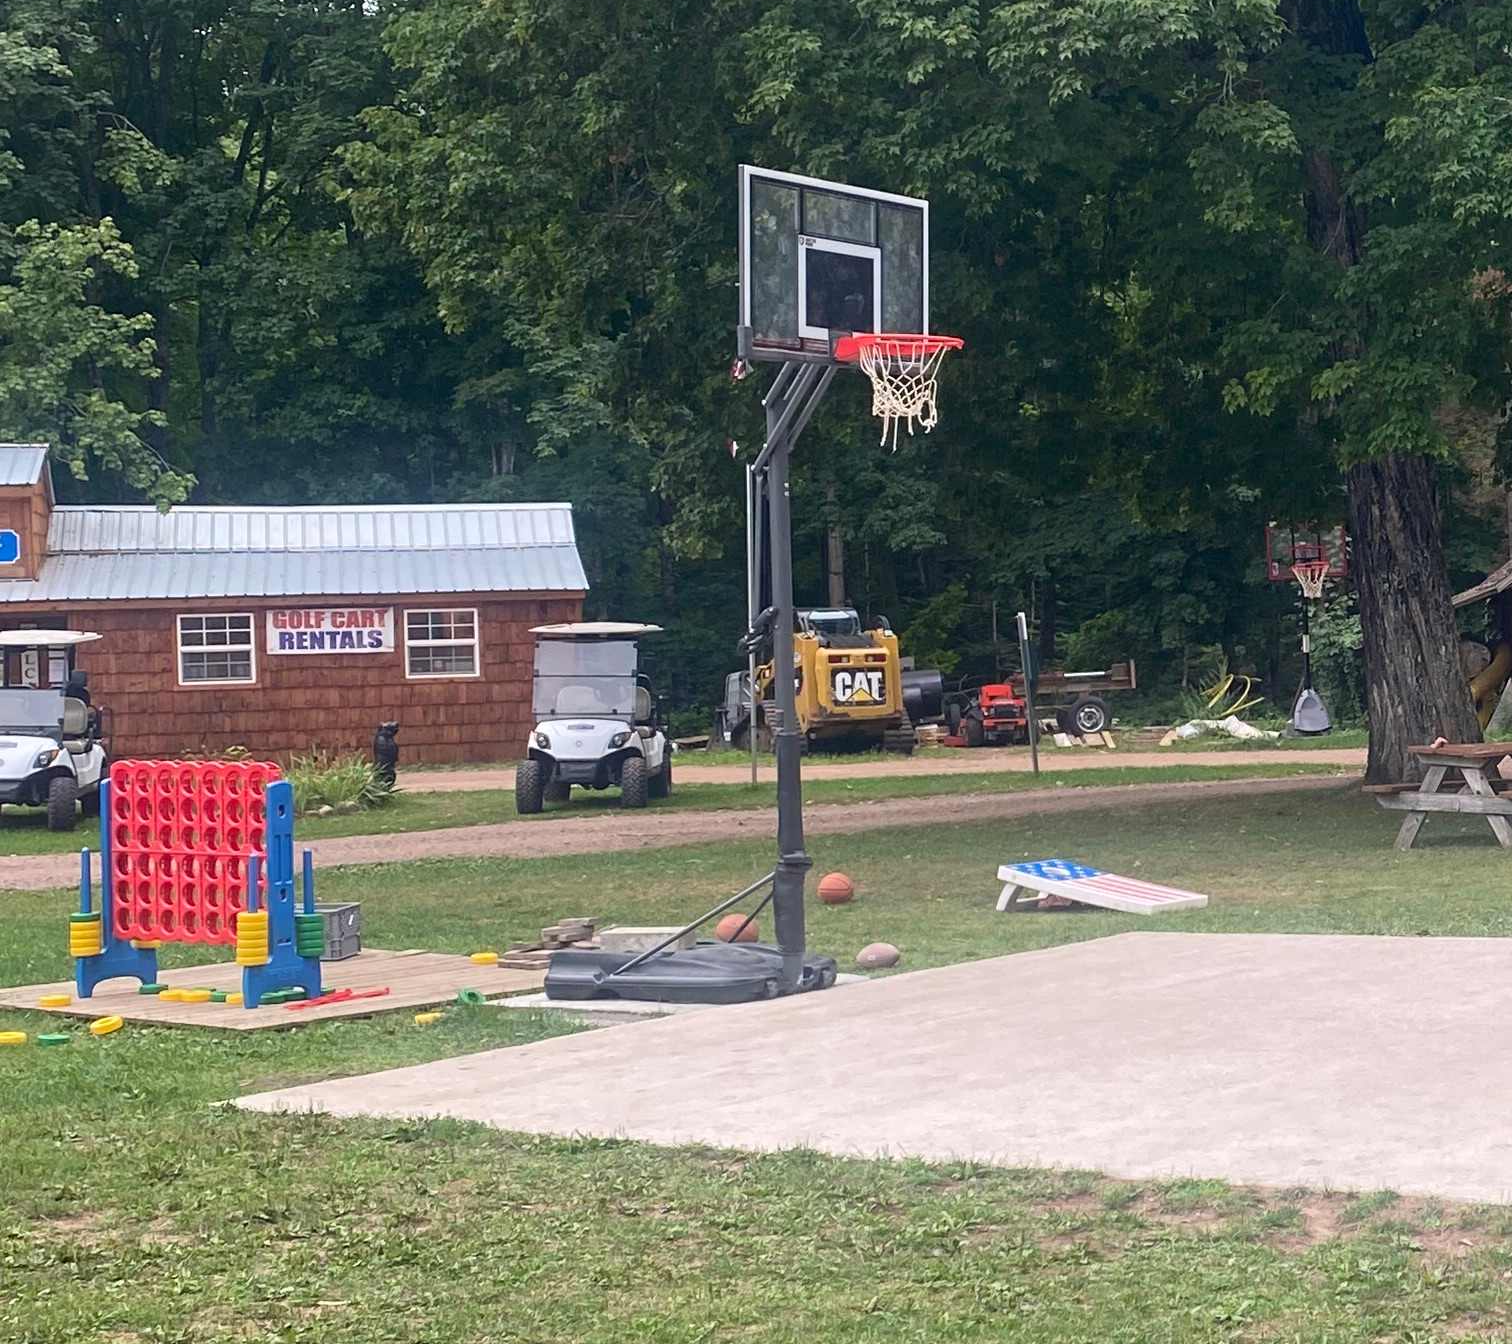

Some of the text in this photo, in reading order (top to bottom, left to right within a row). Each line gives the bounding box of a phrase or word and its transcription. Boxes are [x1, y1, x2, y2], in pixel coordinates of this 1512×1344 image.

[272, 608, 387, 629] GOLF CART
[279, 630, 383, 650] RENTALS
[835, 671, 883, 702] CAT
